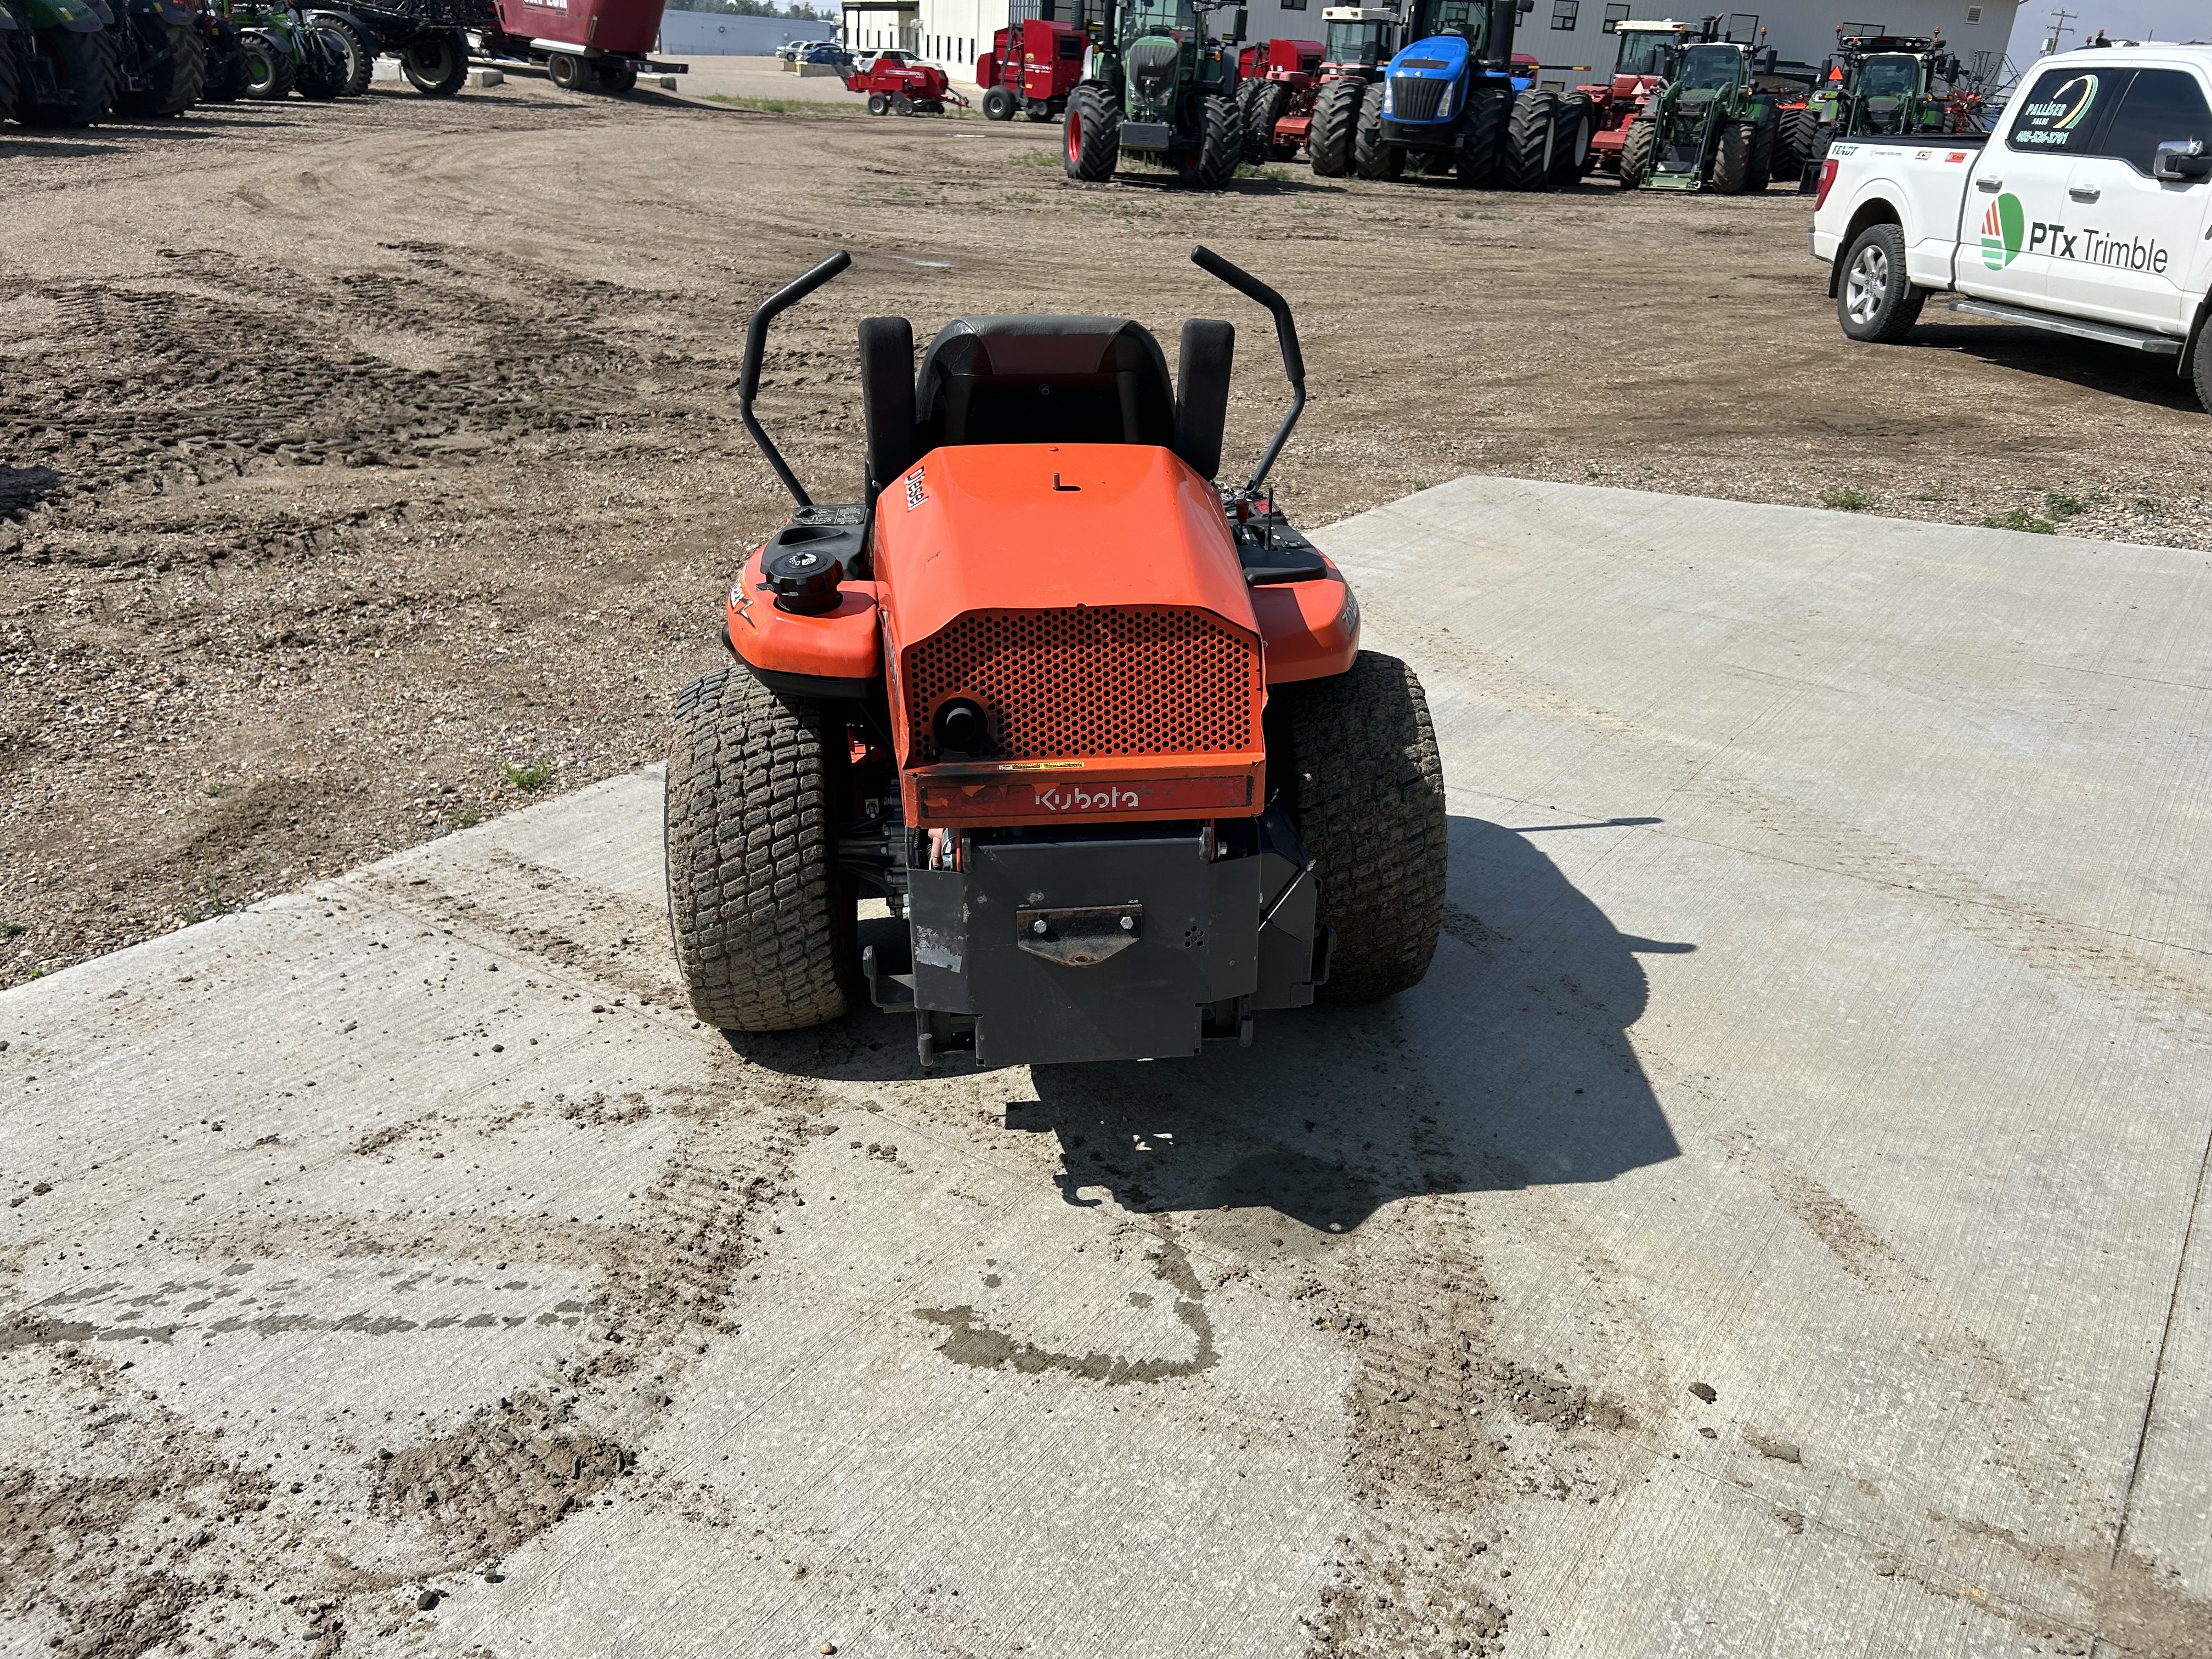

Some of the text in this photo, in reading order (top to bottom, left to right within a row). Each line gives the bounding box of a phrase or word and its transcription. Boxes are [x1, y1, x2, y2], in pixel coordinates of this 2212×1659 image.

[2025, 100, 2067, 116] PALLISER
[1832, 145, 1859, 156] FENDT
[2029, 222, 2168, 273] PTx Trimble
[904, 466, 929, 512] Diesel
[1035, 786, 1138, 810] Kubota
